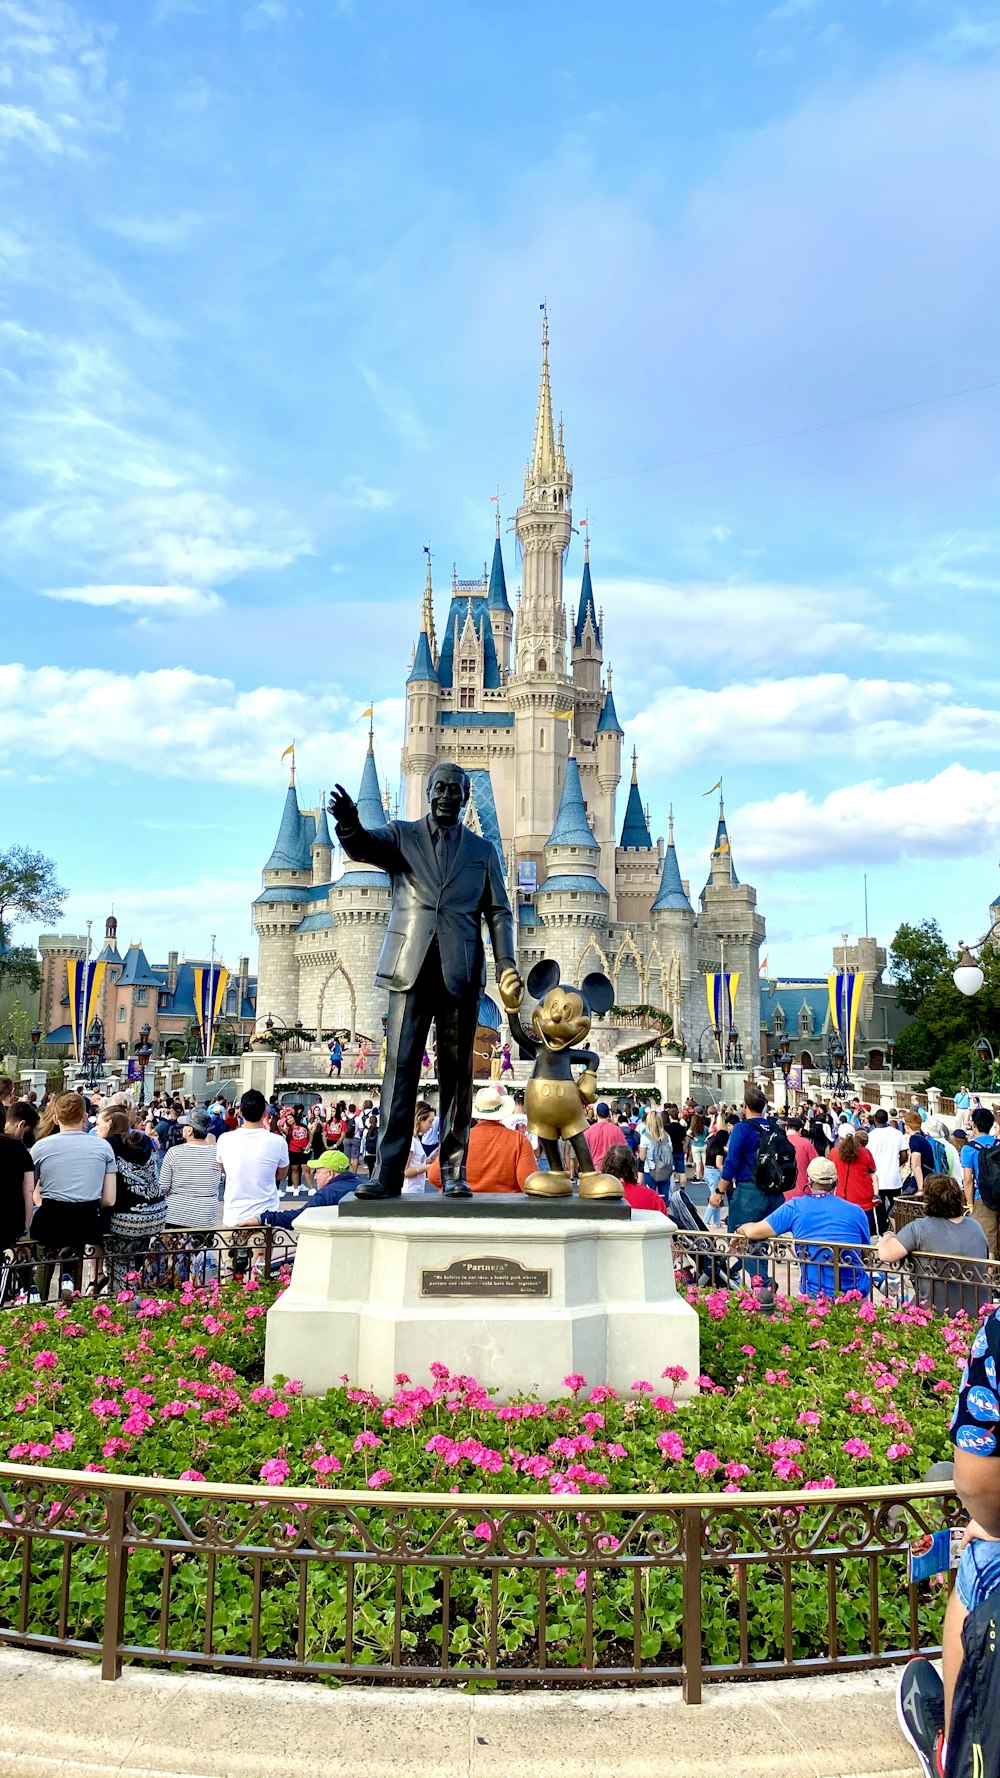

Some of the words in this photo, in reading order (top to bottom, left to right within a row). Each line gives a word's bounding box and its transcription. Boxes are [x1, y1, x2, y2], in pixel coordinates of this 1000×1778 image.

[462, 1263, 508, 1271] "Partners"
[968, 1392, 1000, 1417] NASA
[958, 1437, 994, 1450] NASA
